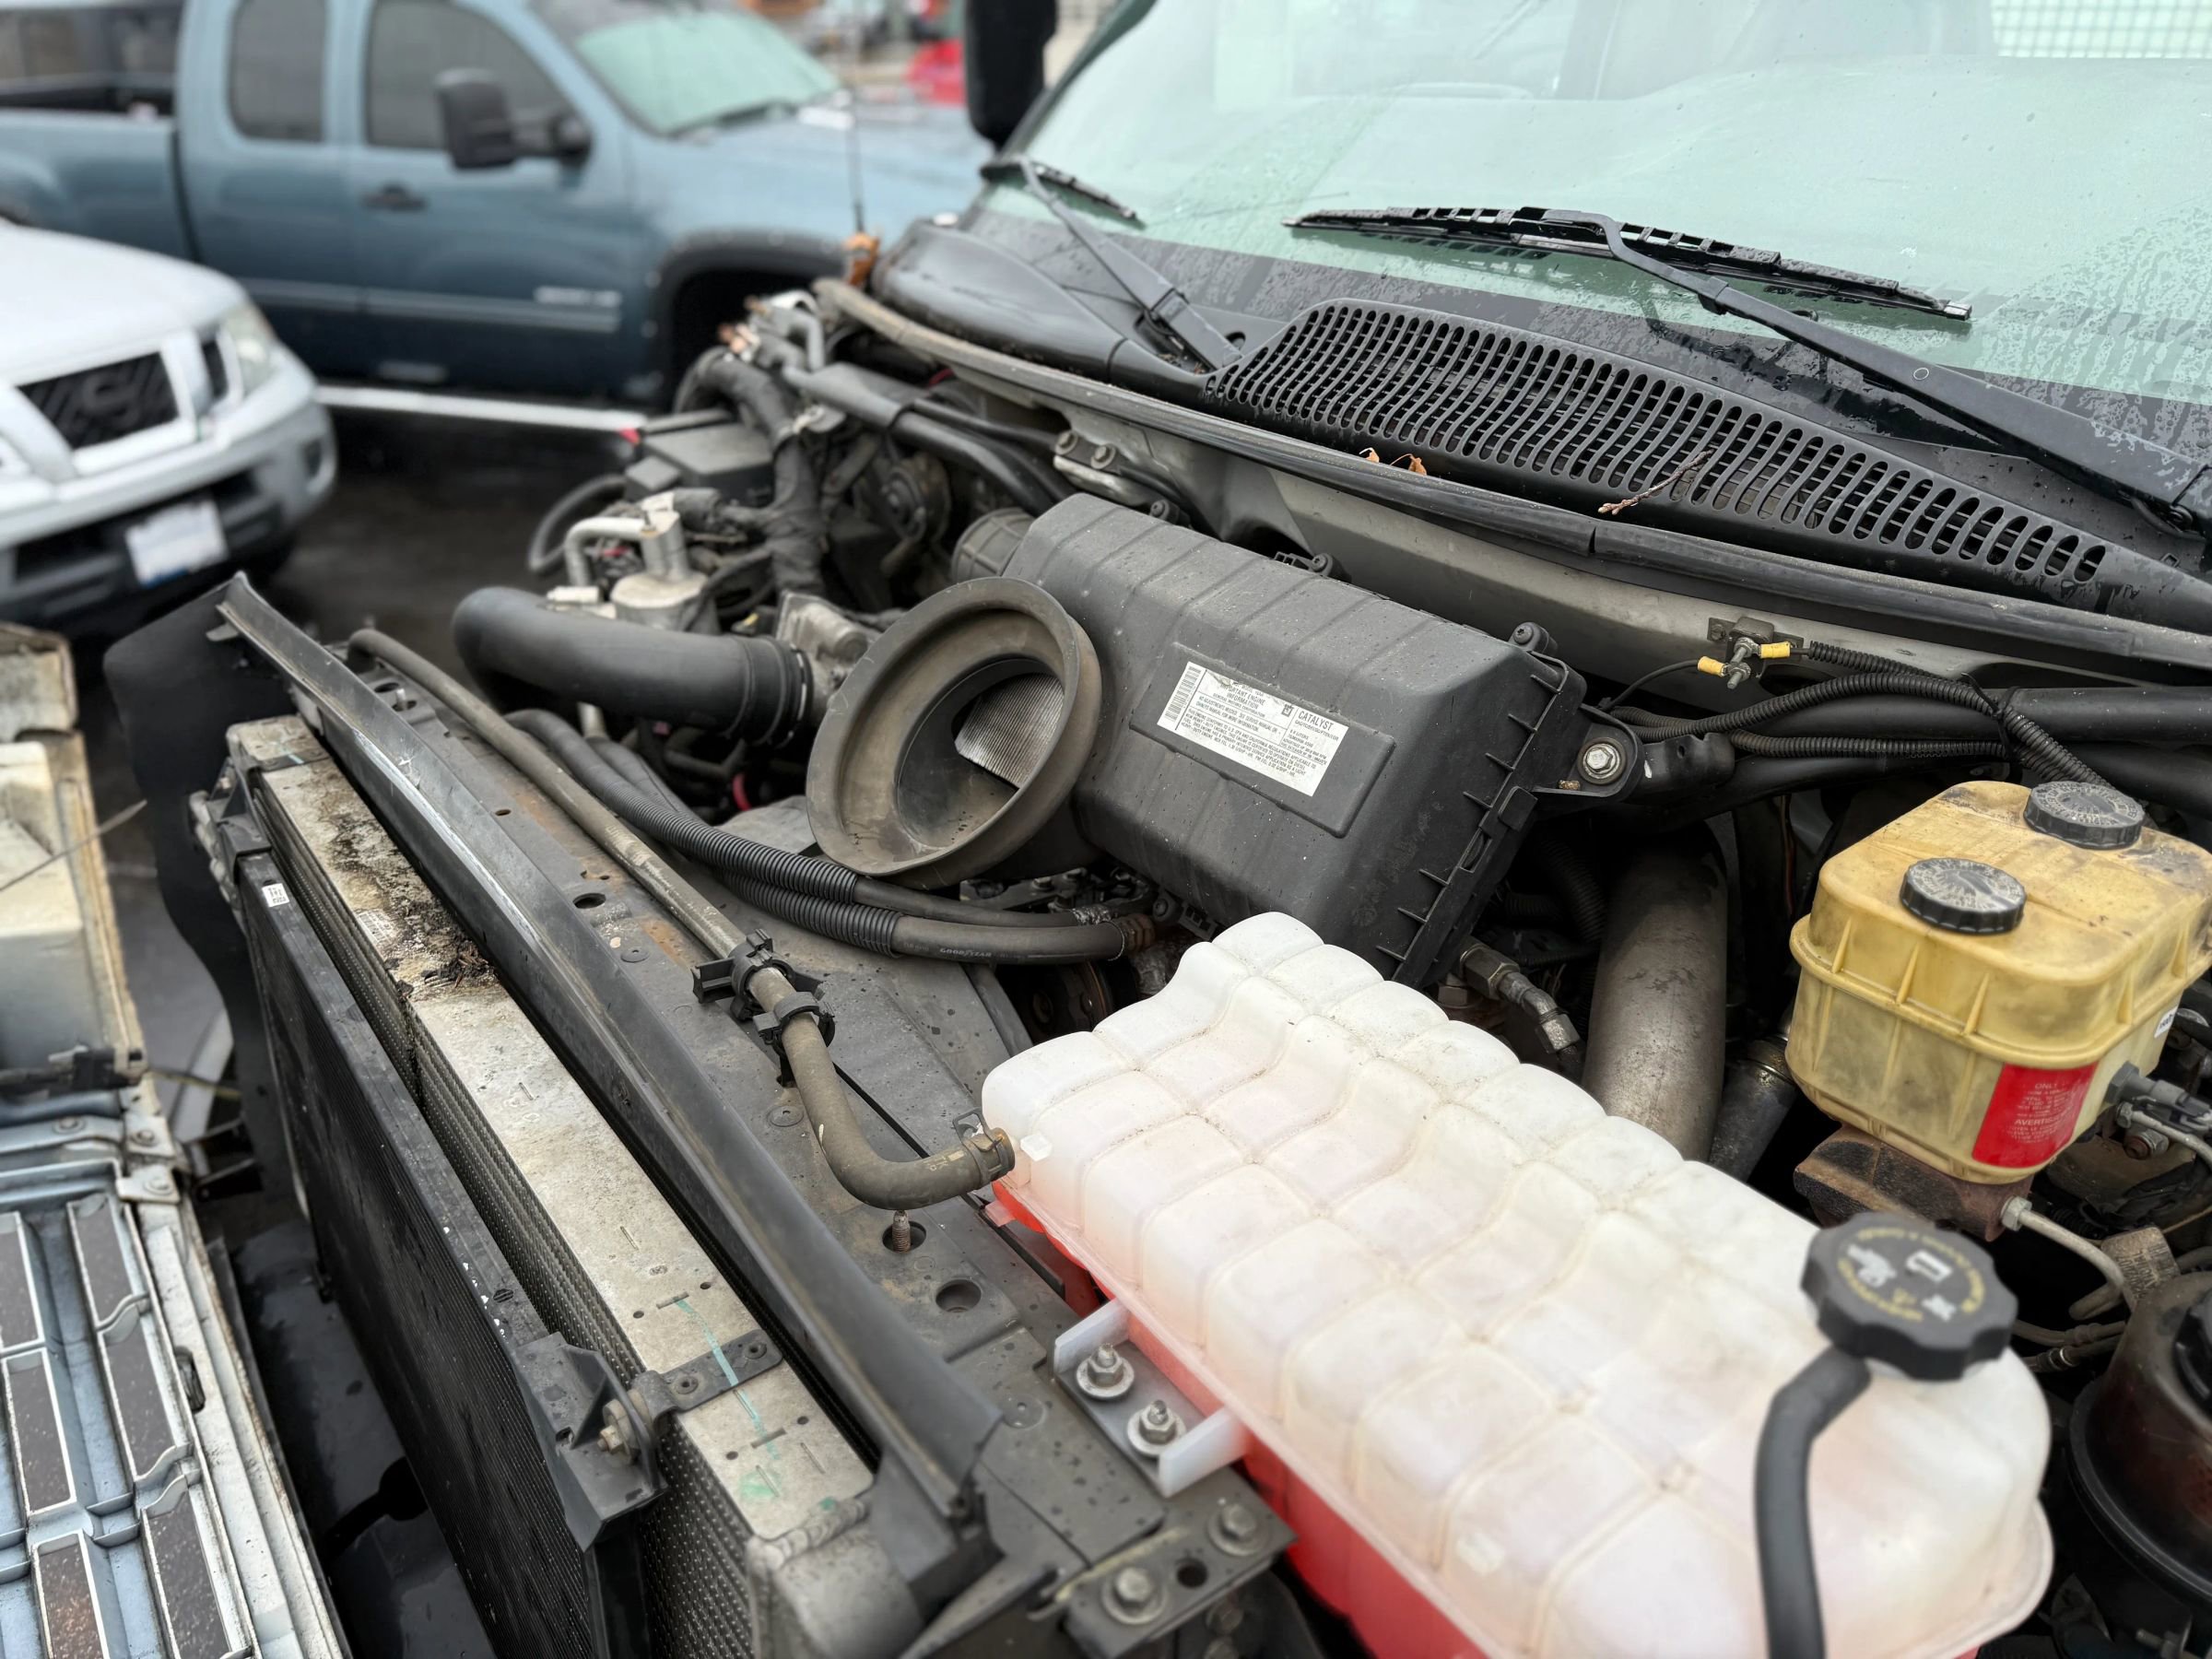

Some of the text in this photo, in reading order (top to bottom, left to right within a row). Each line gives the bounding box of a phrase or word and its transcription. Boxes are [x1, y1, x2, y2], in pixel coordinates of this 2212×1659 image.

[1226, 691, 1259, 710] INFORMATION
[1246, 693, 1265, 705] ENGINE
[1203, 697, 1225, 710] ADJUSTMENTS
[1244, 715, 1258, 724] SERVICE
[1257, 721, 1272, 730] MANUAL
[1297, 710, 1334, 731] CATALYST
[1194, 712, 1206, 720] ENGINE
[1206, 716, 1223, 727] CONFORMS
[1248, 735, 1267, 747] CALIFORNIA
[1266, 744, 1290, 758] REGULATIONS
[1289, 754, 1311, 767] APPLICABLE
[1199, 724, 1212, 734] ENGINE
[1220, 734, 1236, 745] PRIMARY
[1235, 740, 1252, 751] INTENDED
[1251, 747, 1265, 758] SERVICE
[1265, 754, 1287, 768] APPLICATION
[1234, 735, 1248, 744] ENGINE
[1250, 742, 1268, 753] CERTIFIED
[1272, 751, 1288, 762] OPERATE
